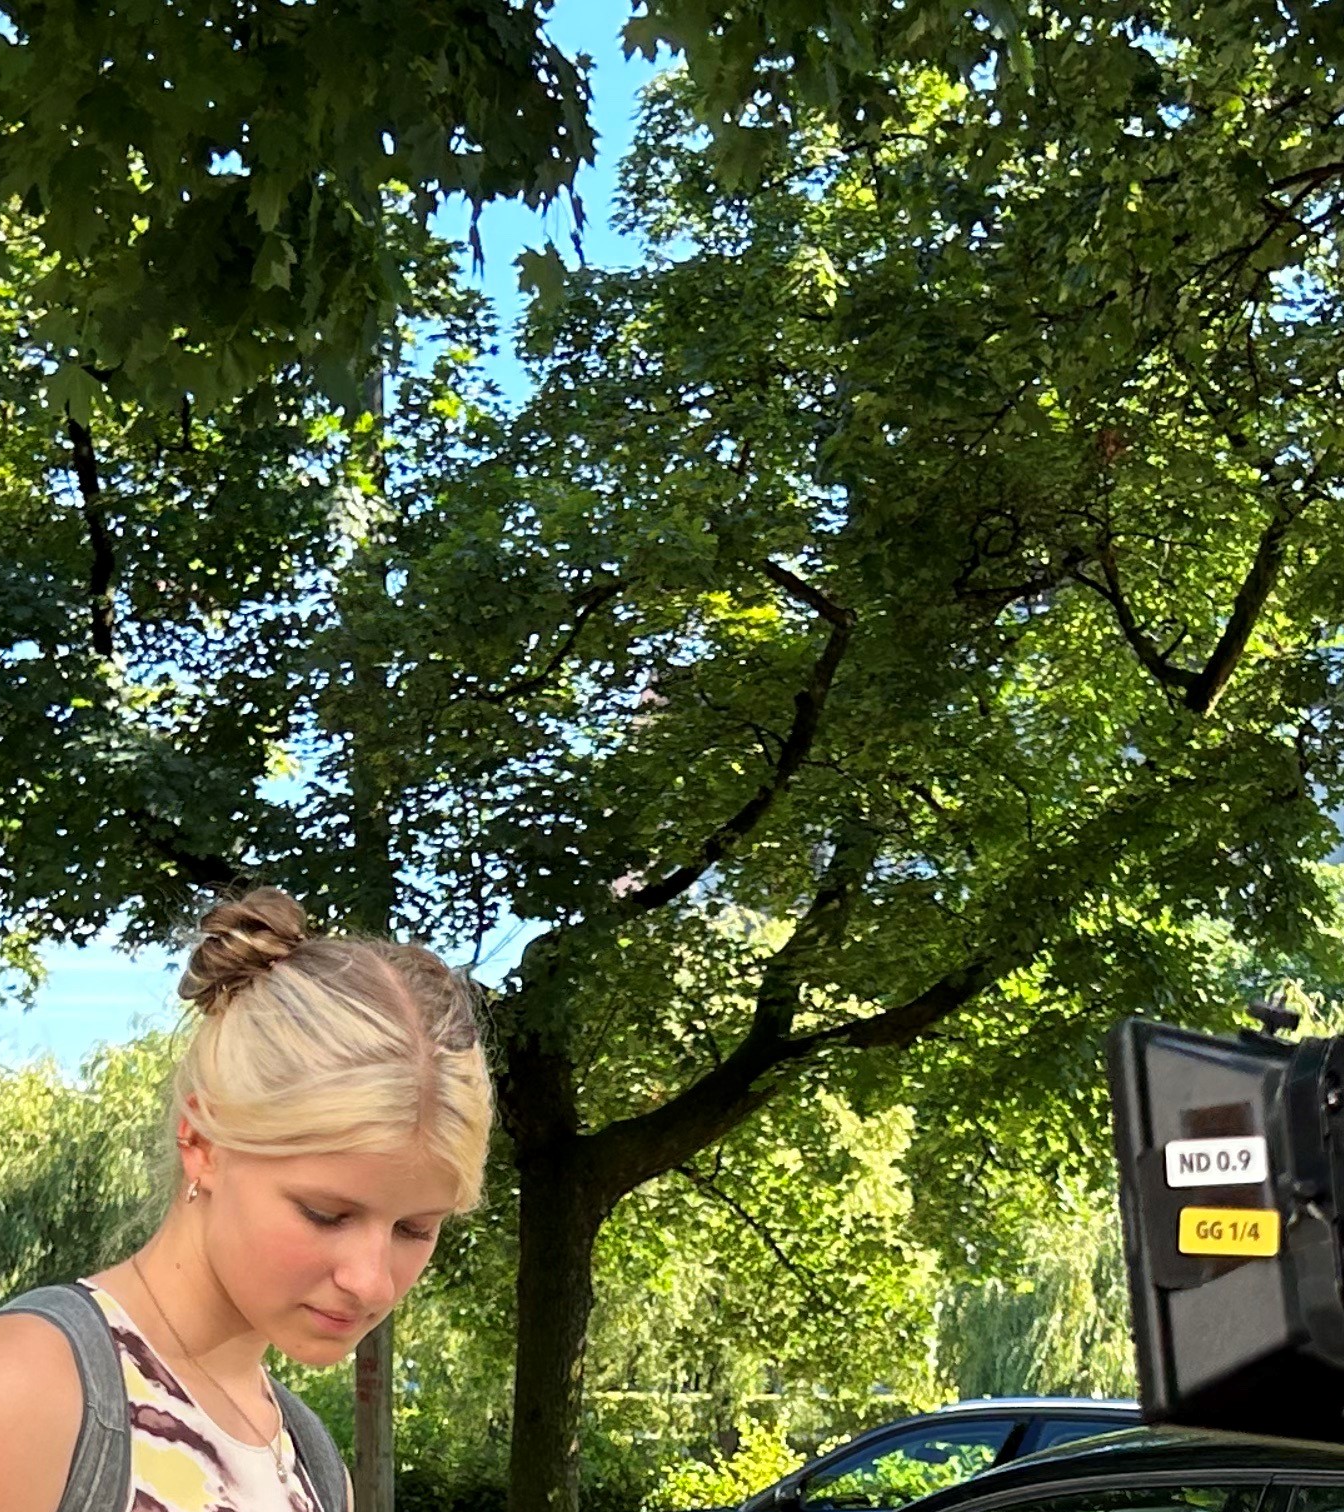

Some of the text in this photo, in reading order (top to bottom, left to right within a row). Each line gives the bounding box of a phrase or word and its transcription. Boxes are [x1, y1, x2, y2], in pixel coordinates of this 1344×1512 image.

[1179, 1149, 1251, 1174] ND 0.9
[1196, 1220, 1260, 1242] GG 1/4
